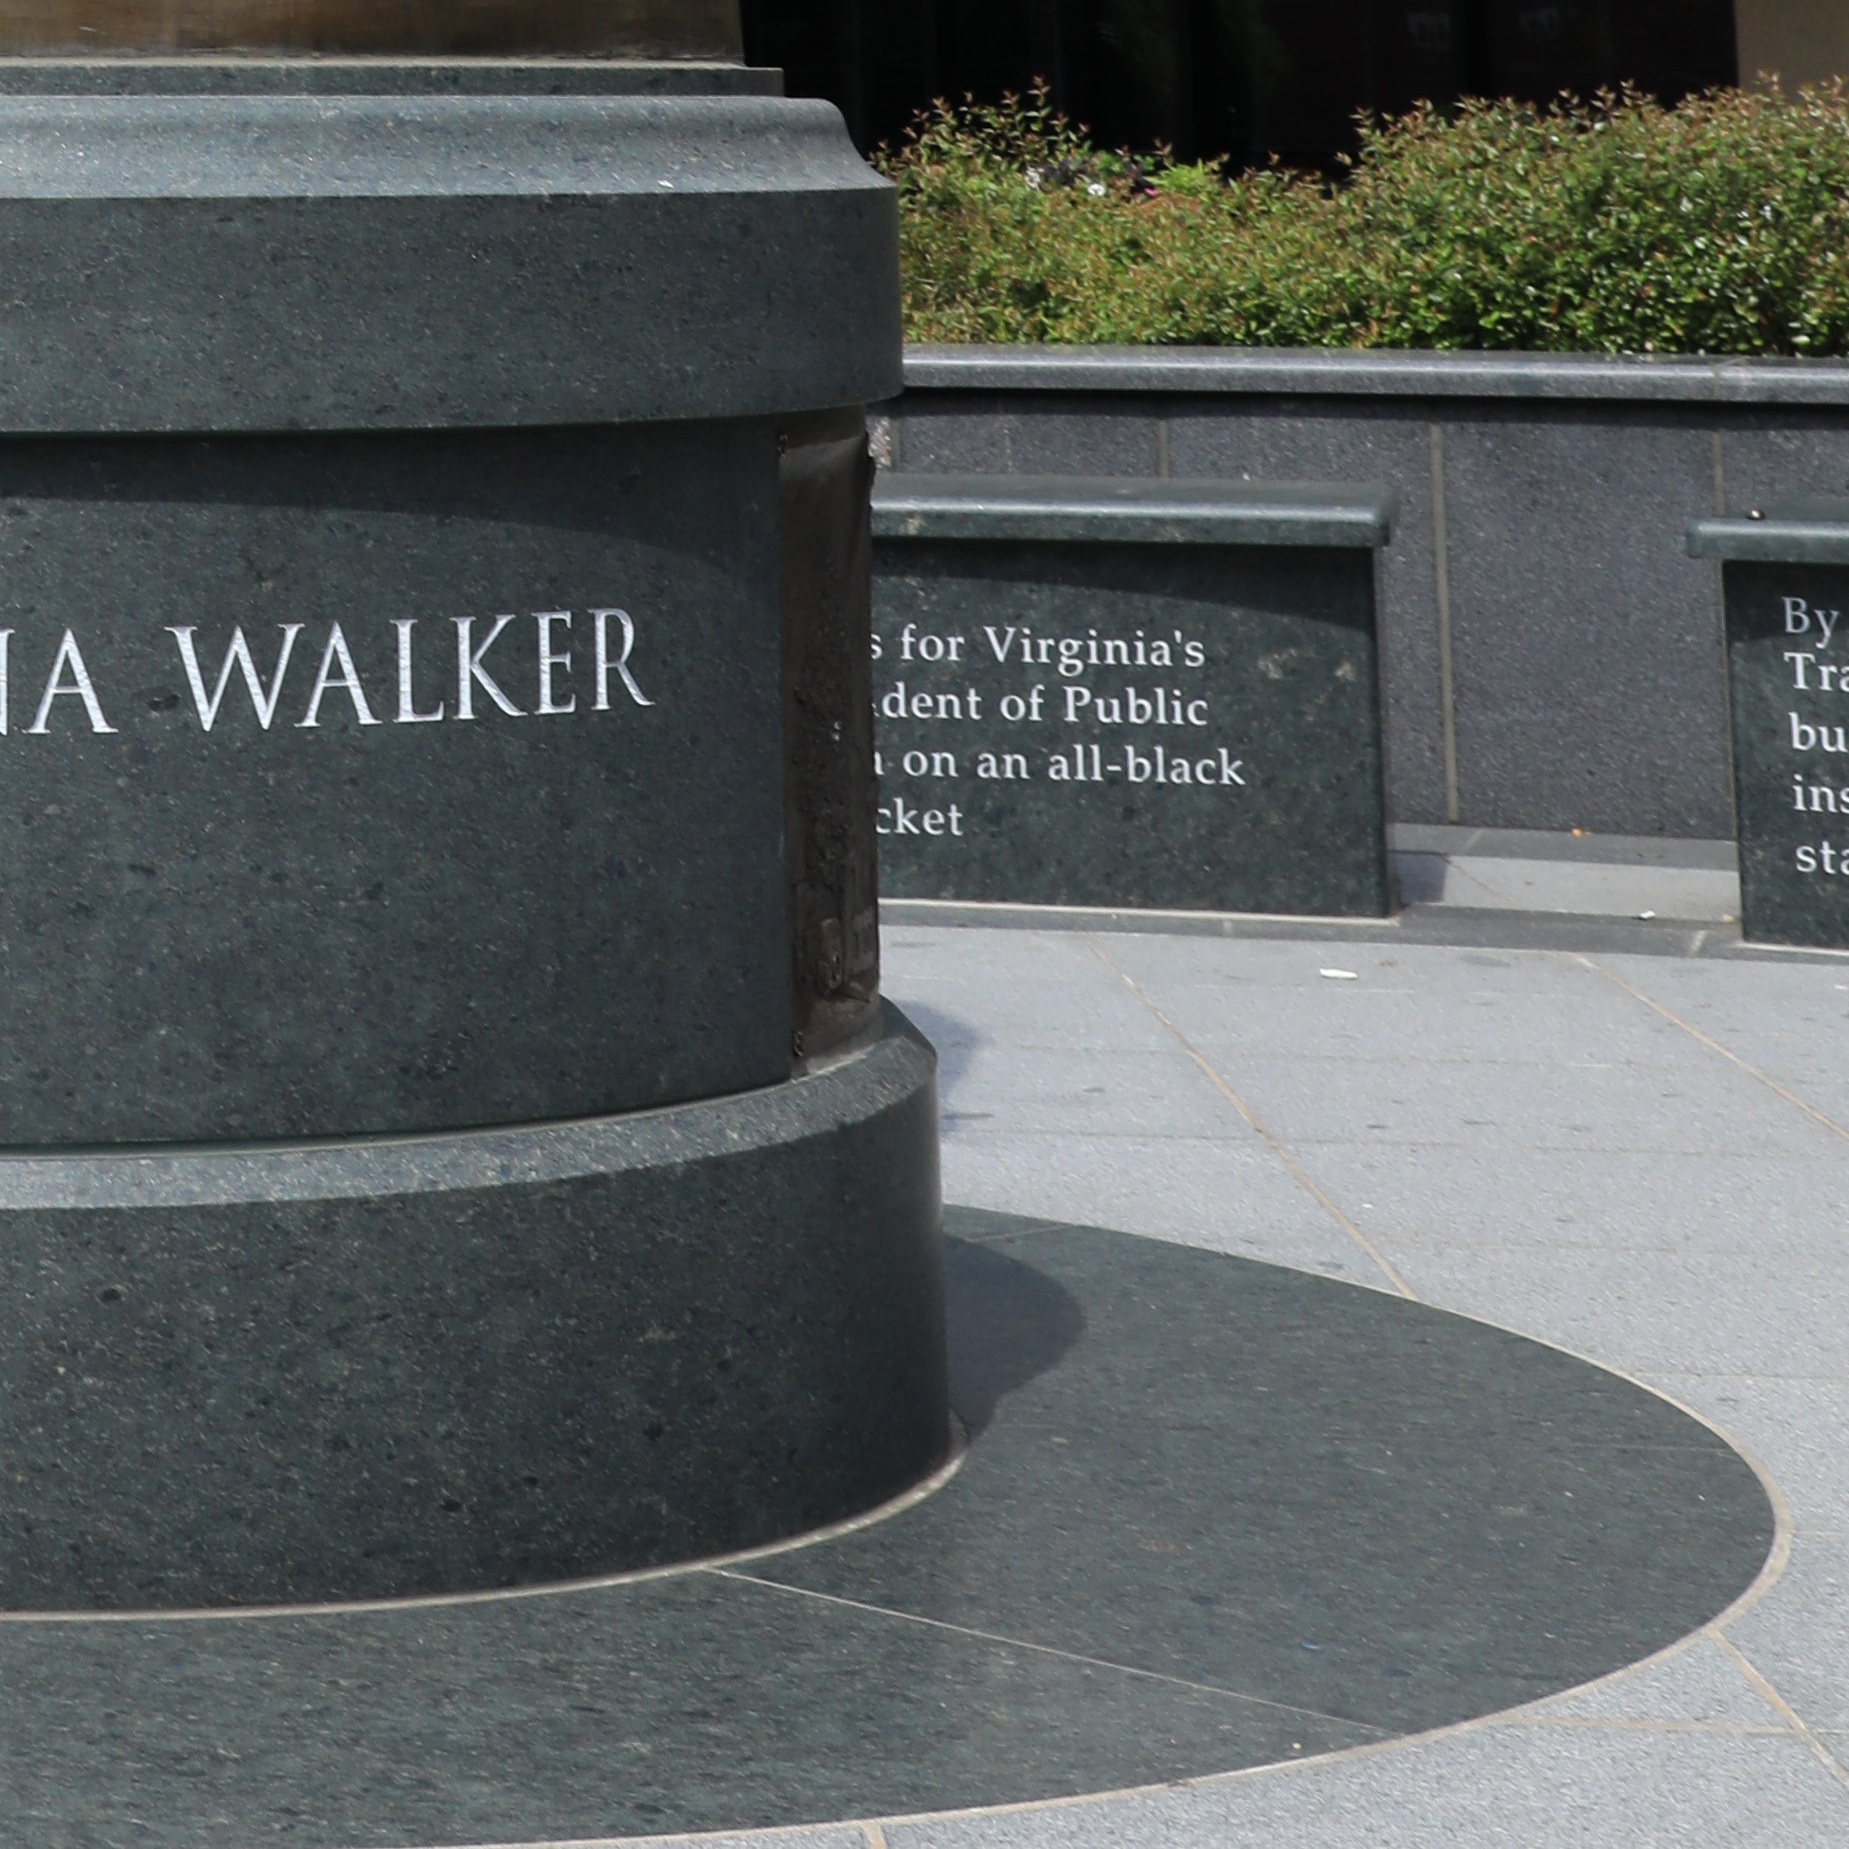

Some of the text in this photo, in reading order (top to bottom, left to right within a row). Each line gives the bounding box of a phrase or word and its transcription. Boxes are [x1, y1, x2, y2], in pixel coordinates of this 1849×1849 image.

[1782, 596, 1840, 649] By
[164, 608, 656, 732] WALKER
[900, 623, 965, 662] for
[983, 626, 1205, 677] Virginia's
[872, 681, 1209, 726] dent of Public
[902, 750, 959, 778] on
[976, 751, 1031, 780] an
[1048, 744, 1246, 786] all-black
